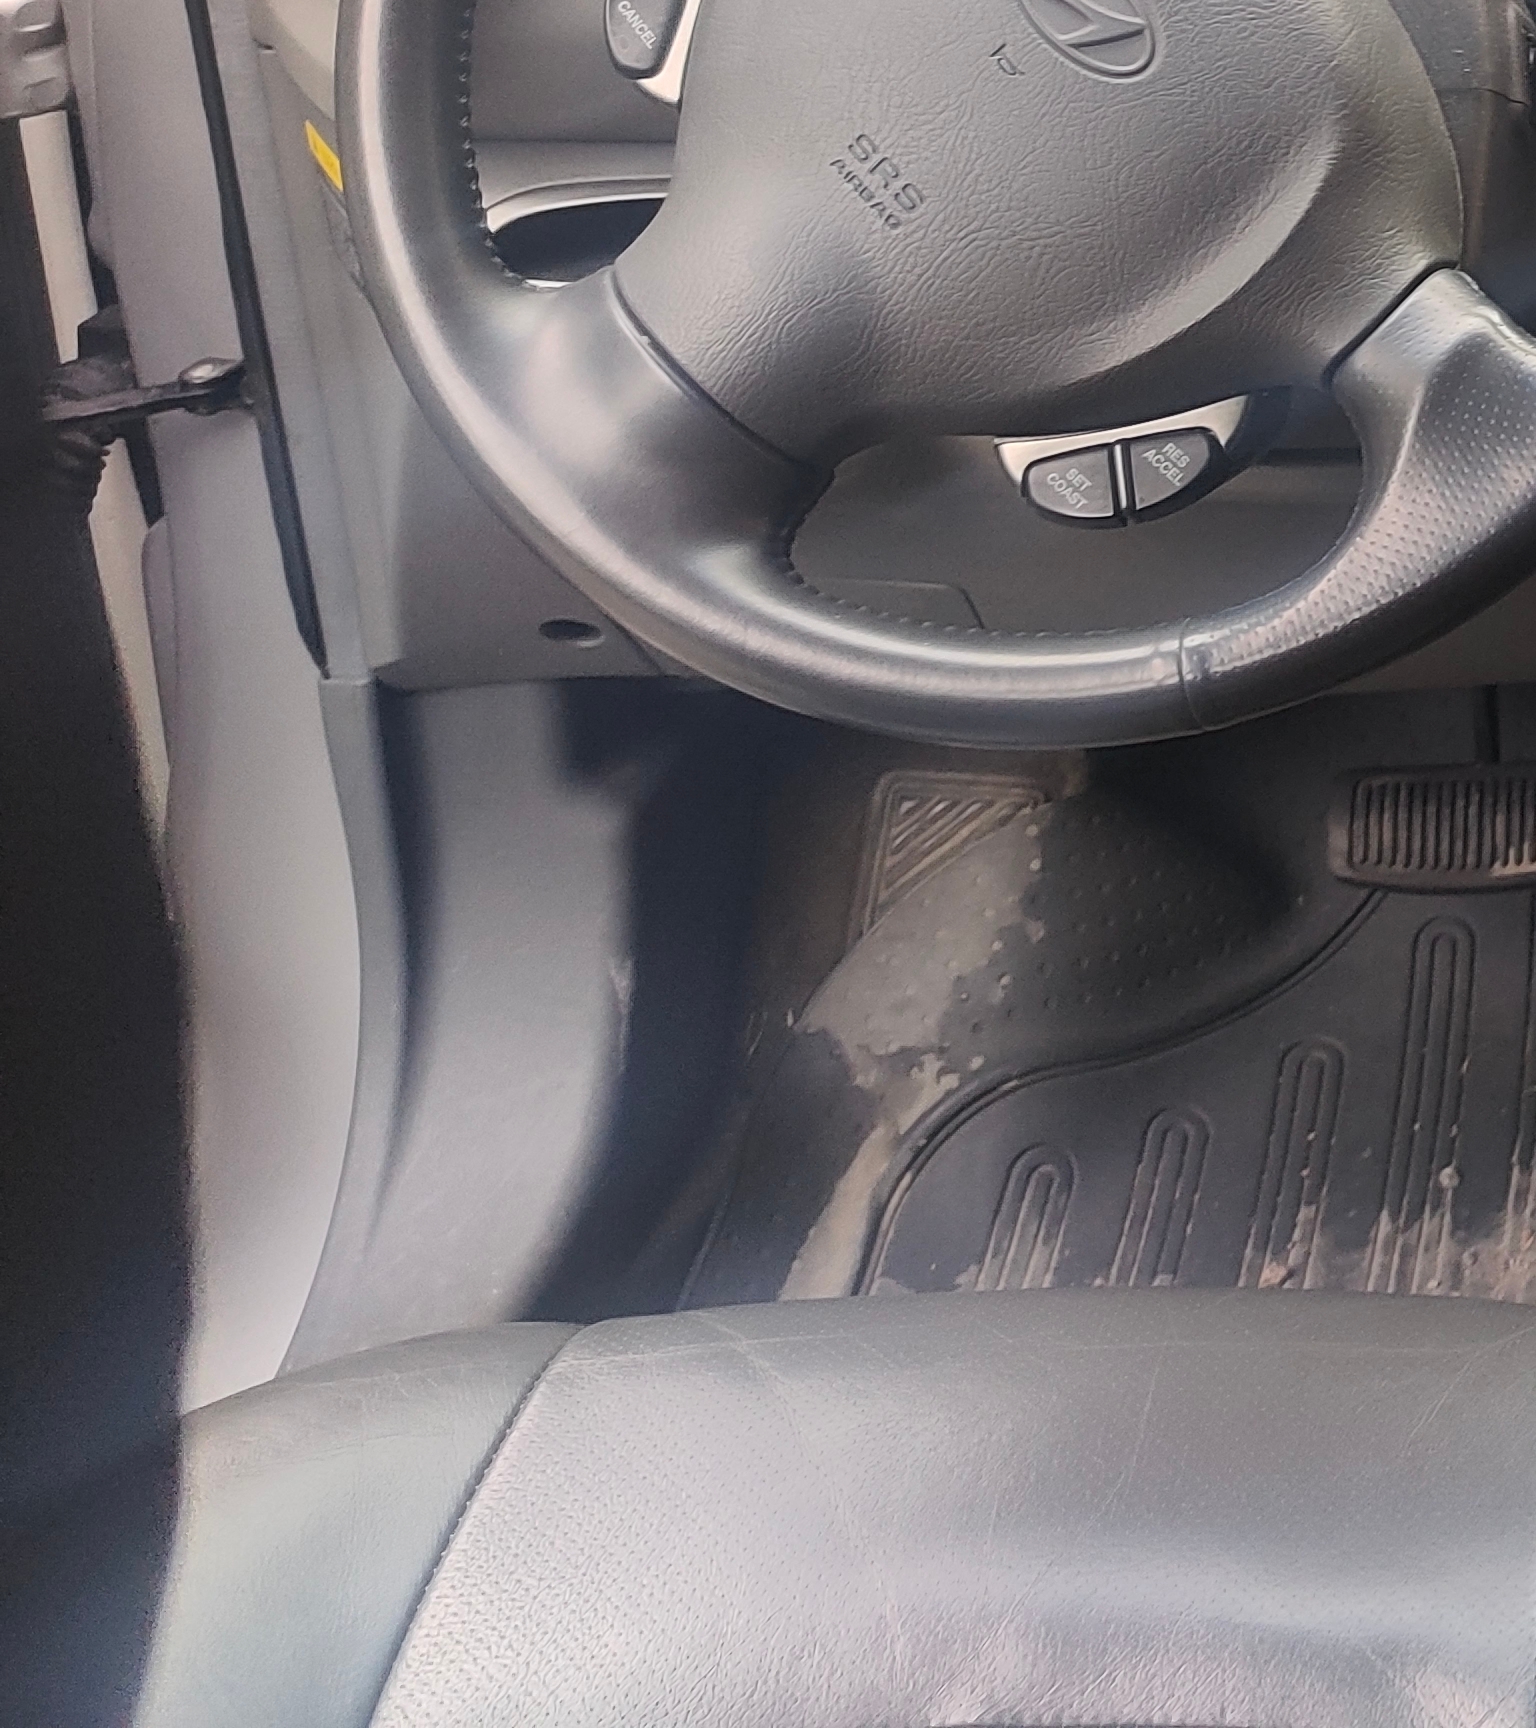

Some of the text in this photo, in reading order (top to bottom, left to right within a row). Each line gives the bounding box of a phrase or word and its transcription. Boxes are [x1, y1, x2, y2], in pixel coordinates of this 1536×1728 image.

[617, 0, 657, 50] CANCEL
[847, 134, 925, 212] SRS
[829, 159, 903, 231] AIRBAG
[1142, 448, 1185, 487] ACCEL
[1161, 442, 1191, 468] RES
[1046, 472, 1089, 509] COAST
[1065, 467, 1093, 491] SET
